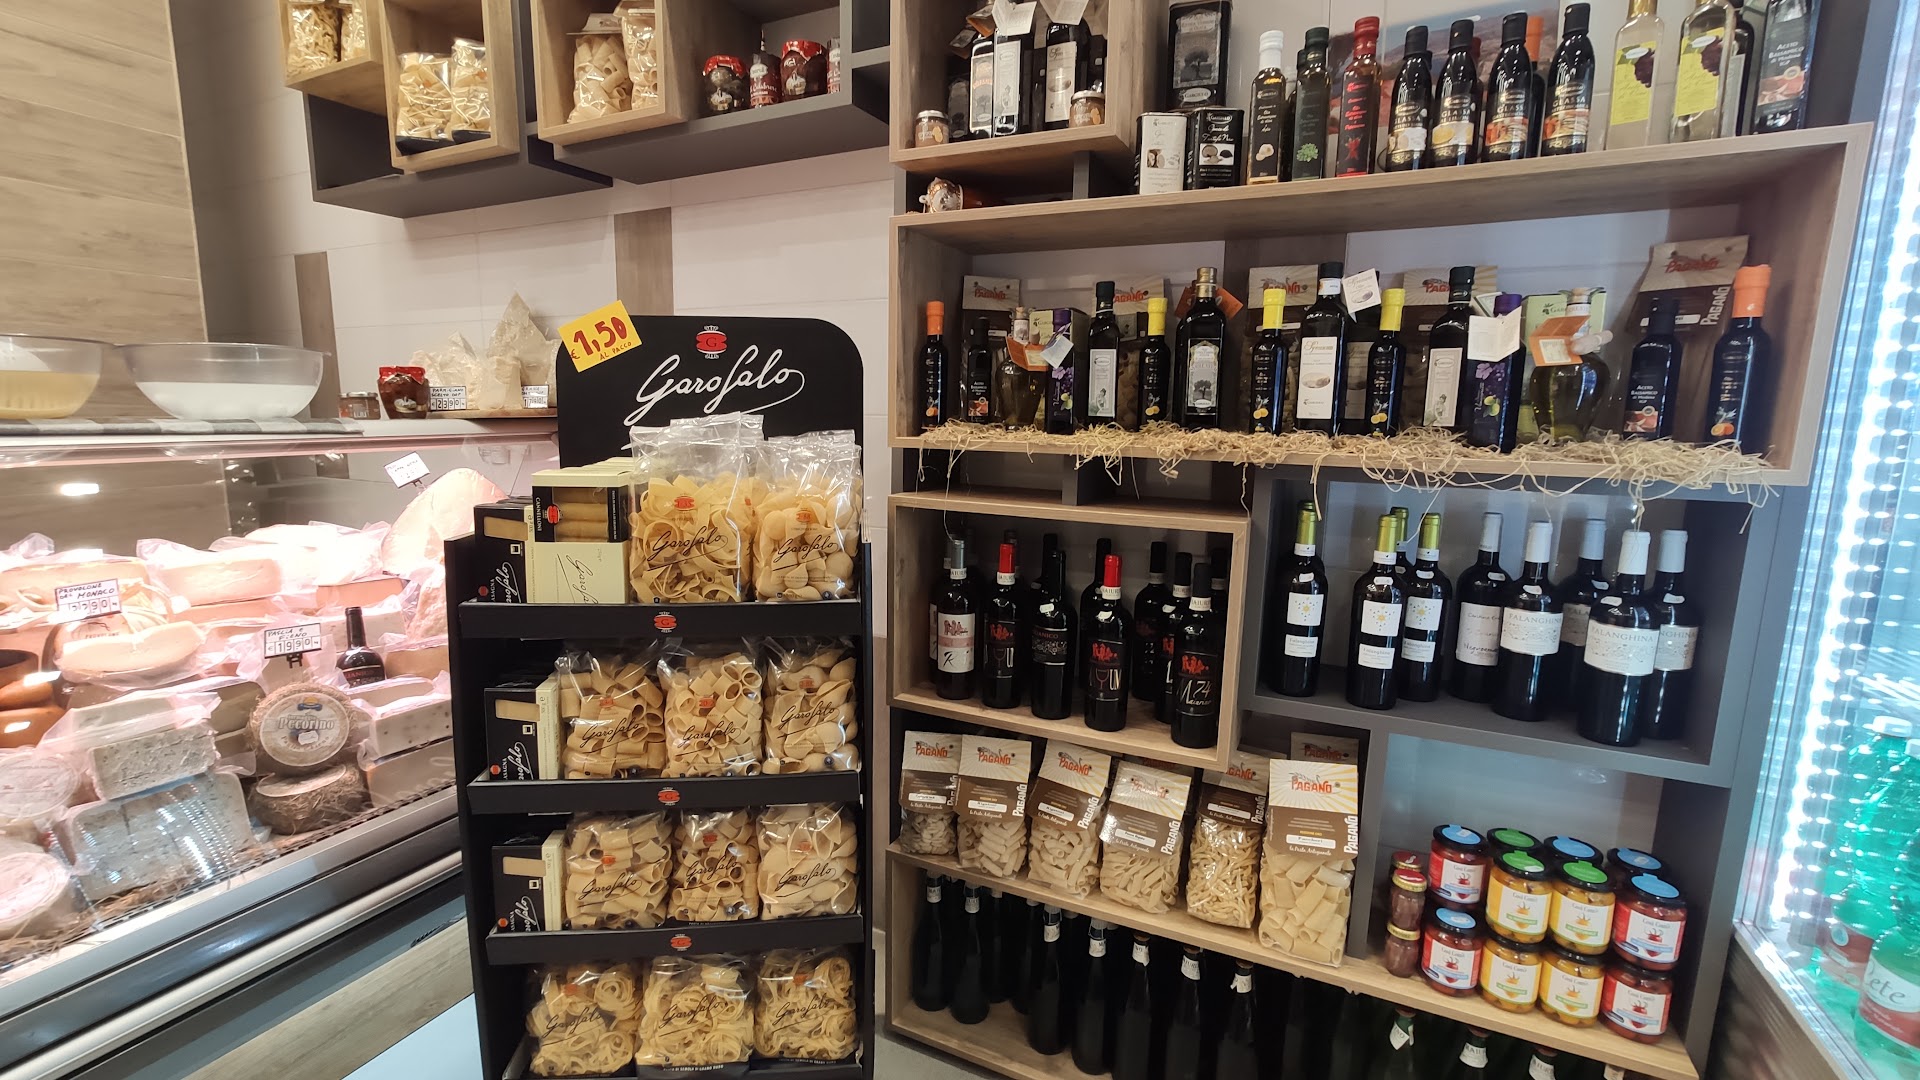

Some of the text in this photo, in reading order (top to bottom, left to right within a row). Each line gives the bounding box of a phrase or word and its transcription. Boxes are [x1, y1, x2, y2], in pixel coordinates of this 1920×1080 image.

[1113, 290, 1144, 303] AGANO
[1700, 286, 1731, 325] PAGANO
[572, 315, 628, 357] 1,50
[611, 340, 632, 356] PACCO
[623, 344, 804, 427] Garofalo
[535, 497, 543, 532] CANNELLONI
[647, 525, 728, 562] Garofalo
[773, 534, 838, 563] Garofalo
[77, 588, 115, 599] MONACO
[566, 554, 599, 604] Garofa
[1590, 626, 1654, 642] FALANGHINA
[1659, 630, 1697, 640] NGHINA
[279, 715, 334, 730] Pecorino
[779, 700, 840, 730] Garofalo
[580, 717, 645, 748] Garofalo
[677, 720, 741, 748] Garofalo
[915, 744, 948, 758] PAGANO
[978, 751, 1011, 766] PAGANO
[1058, 755, 1090, 776] PAGANO
[1226, 766, 1254, 781] GANO
[1291, 775, 1333, 794] PAGANO
[1012, 783, 1027, 817] PAGANO
[1077, 796, 1099, 829] PAGANO
[1250, 794, 1266, 825] PAGANO
[1161, 820, 1181, 856] PAGANO
[1343, 815, 1358, 855] PAGANO
[685, 854, 738, 883] Garofalo
[775, 862, 836, 892] Garofalo
[578, 872, 642, 901] Garofalo
[543, 1007, 602, 1038] Garofalo
[659, 994, 725, 1028] Garofalo
[772, 994, 831, 1027] Garofalo
